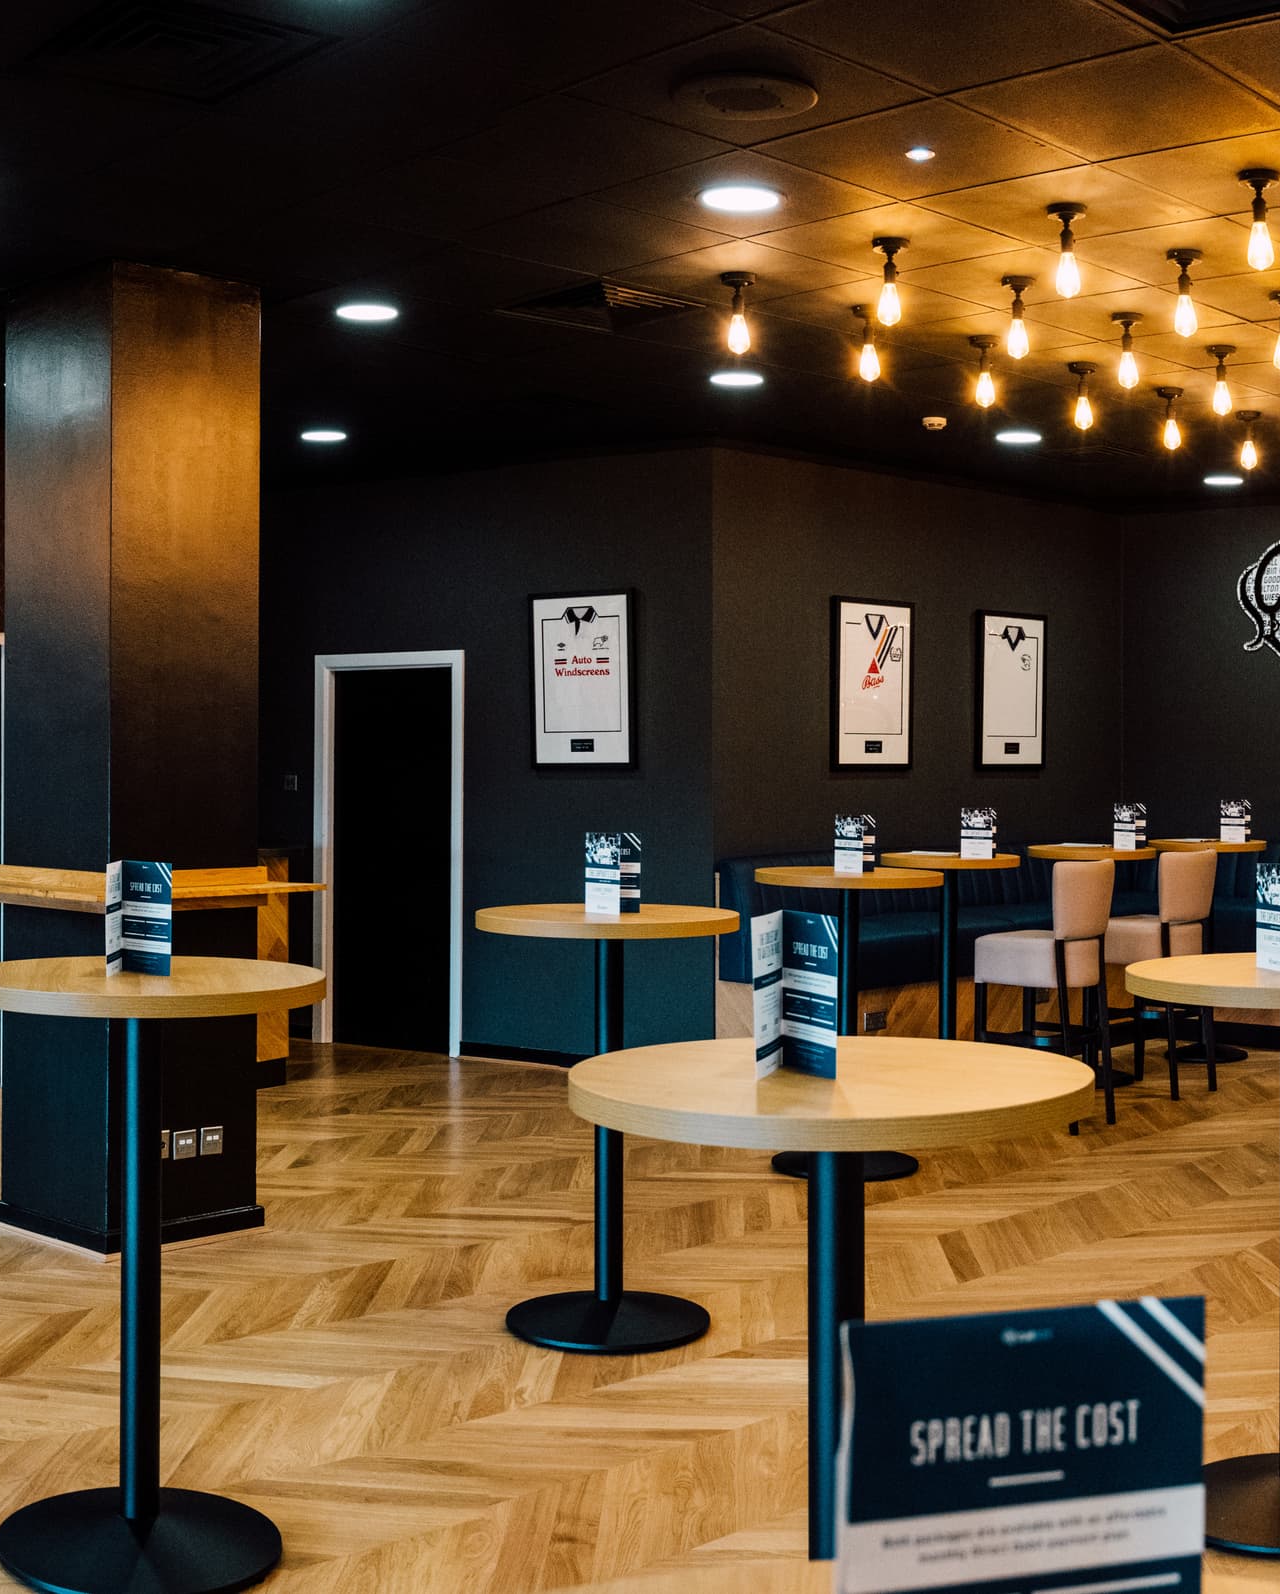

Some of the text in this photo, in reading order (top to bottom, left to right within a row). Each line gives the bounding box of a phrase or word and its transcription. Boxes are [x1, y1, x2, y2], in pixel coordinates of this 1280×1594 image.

[571, 655, 593, 665] Auto
[555, 666, 610, 677] Windscreens
[862, 674, 884, 690] Bass
[909, 1399, 1140, 1467] SPREAD THE COST
